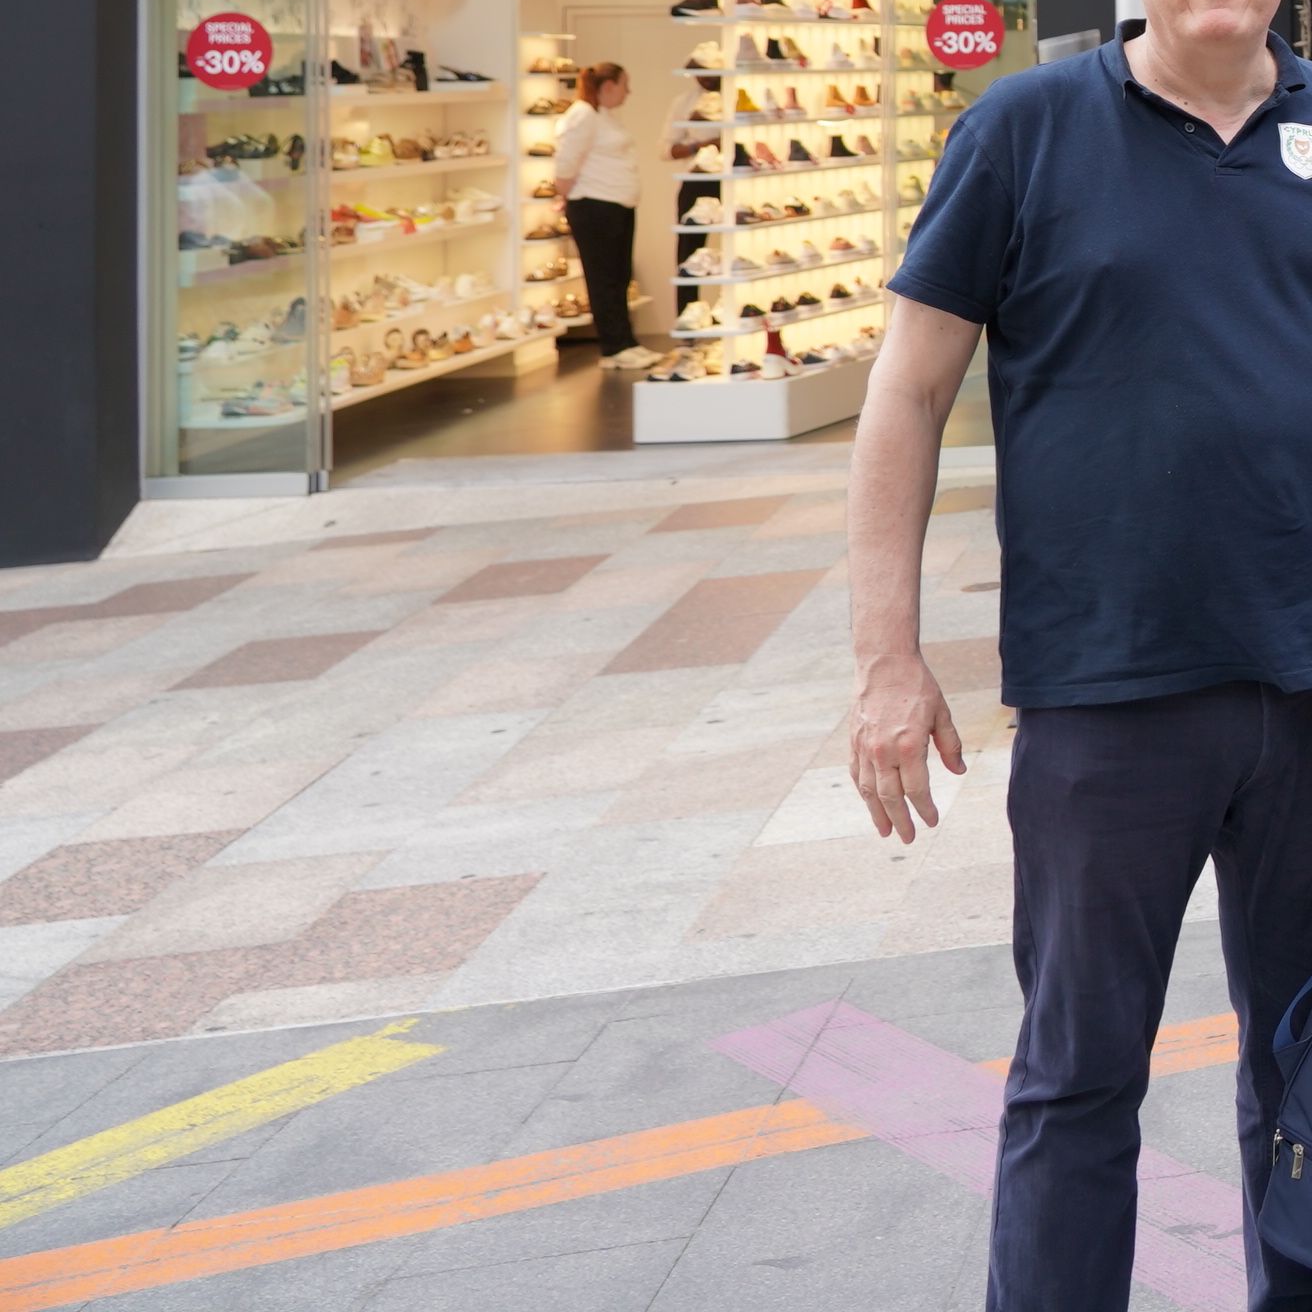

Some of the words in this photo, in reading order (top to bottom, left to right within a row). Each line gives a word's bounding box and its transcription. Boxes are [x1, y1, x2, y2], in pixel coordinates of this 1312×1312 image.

[942, 4, 987, 15] SPECIAL
[944, 15, 985, 25] PRICES
[933, 31, 997, 54] -30%
[195, 49, 265, 75] -30%
